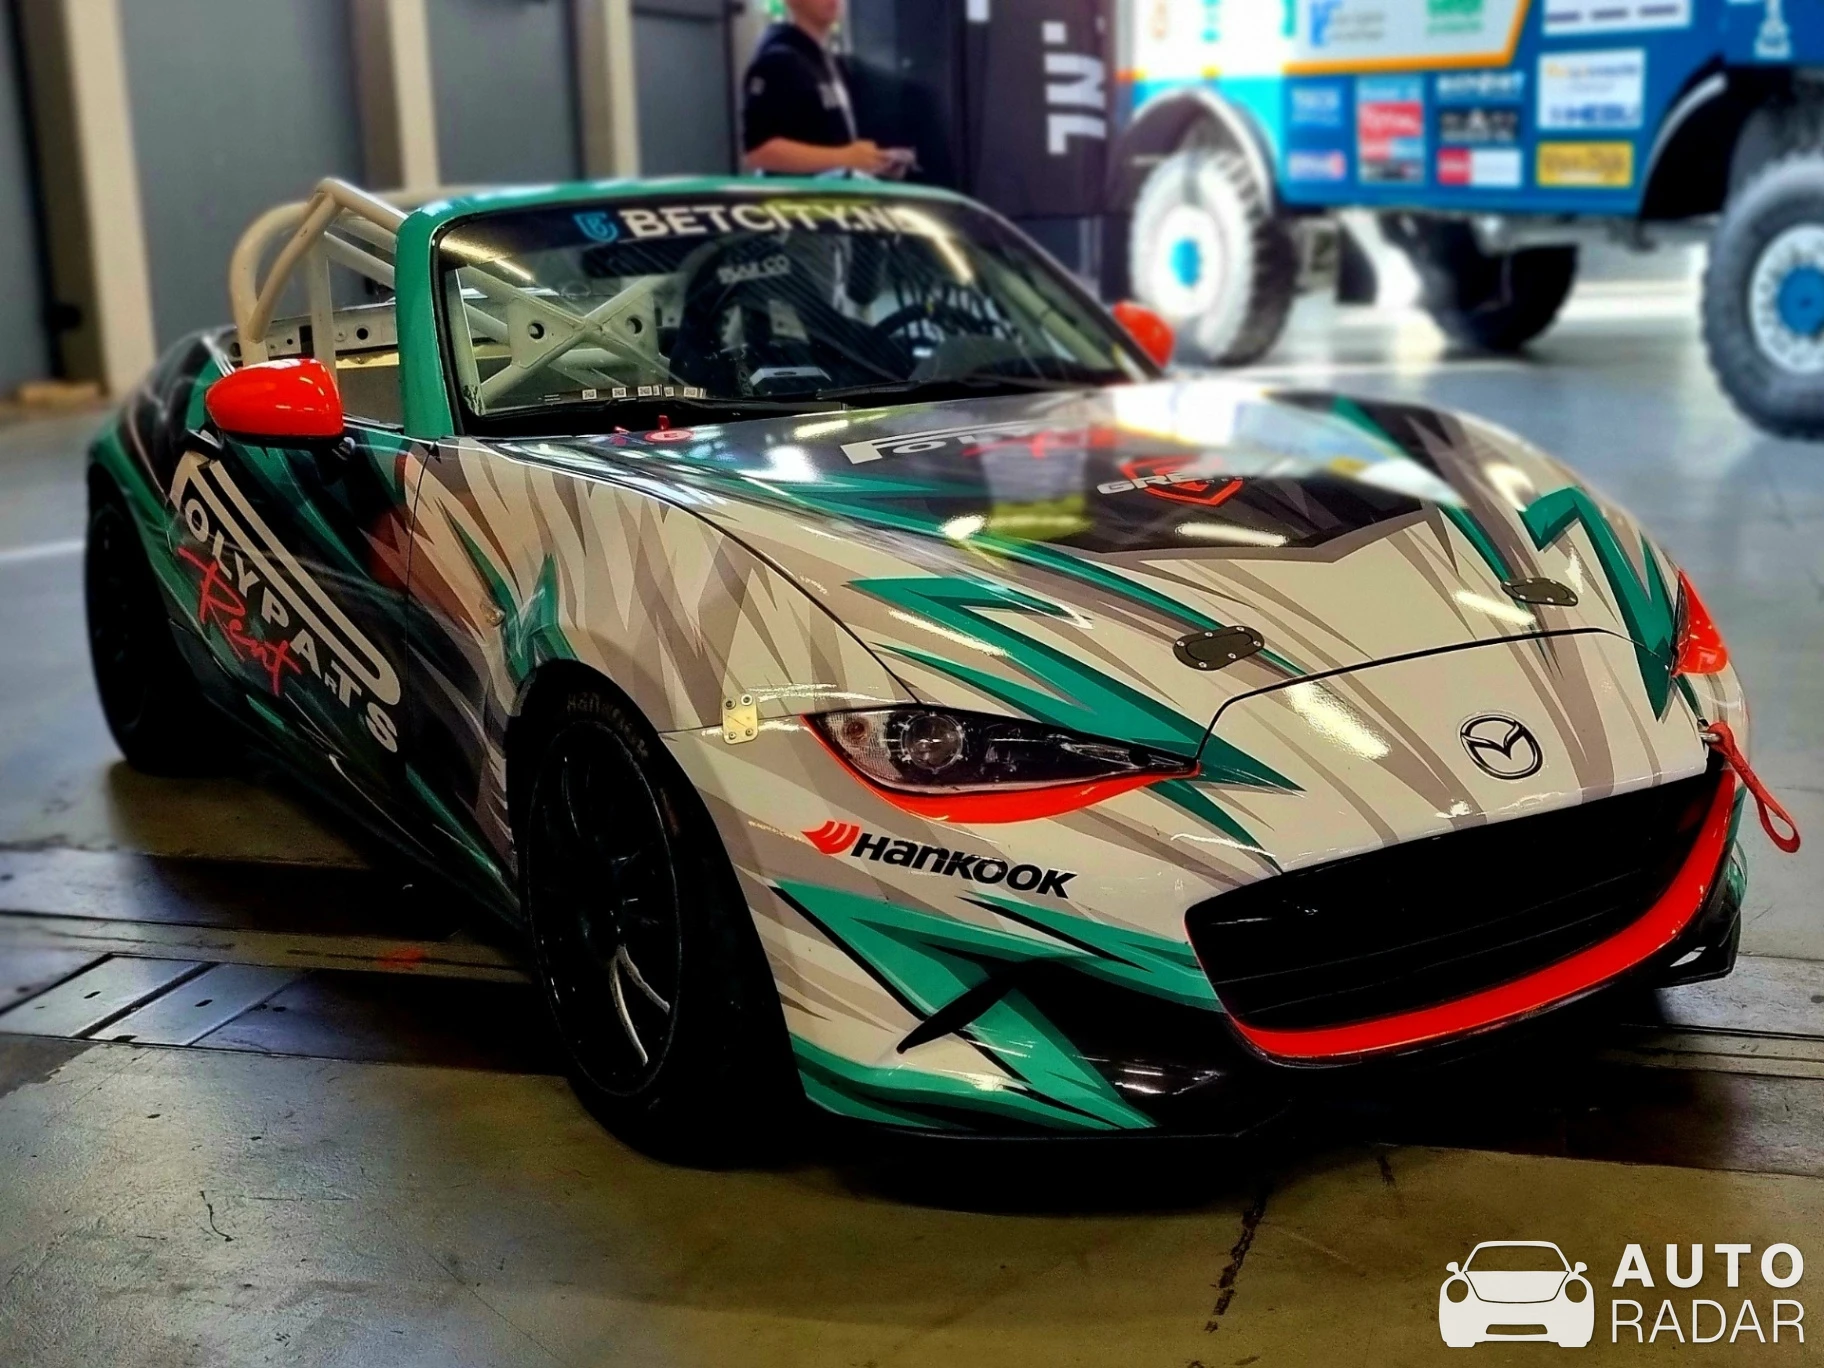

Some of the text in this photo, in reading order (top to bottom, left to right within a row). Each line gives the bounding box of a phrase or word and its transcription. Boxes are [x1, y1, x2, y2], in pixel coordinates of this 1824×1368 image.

[1042, 21, 1106, 155] .NL
[617, 204, 924, 239] BETCITY.NL
[177, 547, 302, 697] Rent
